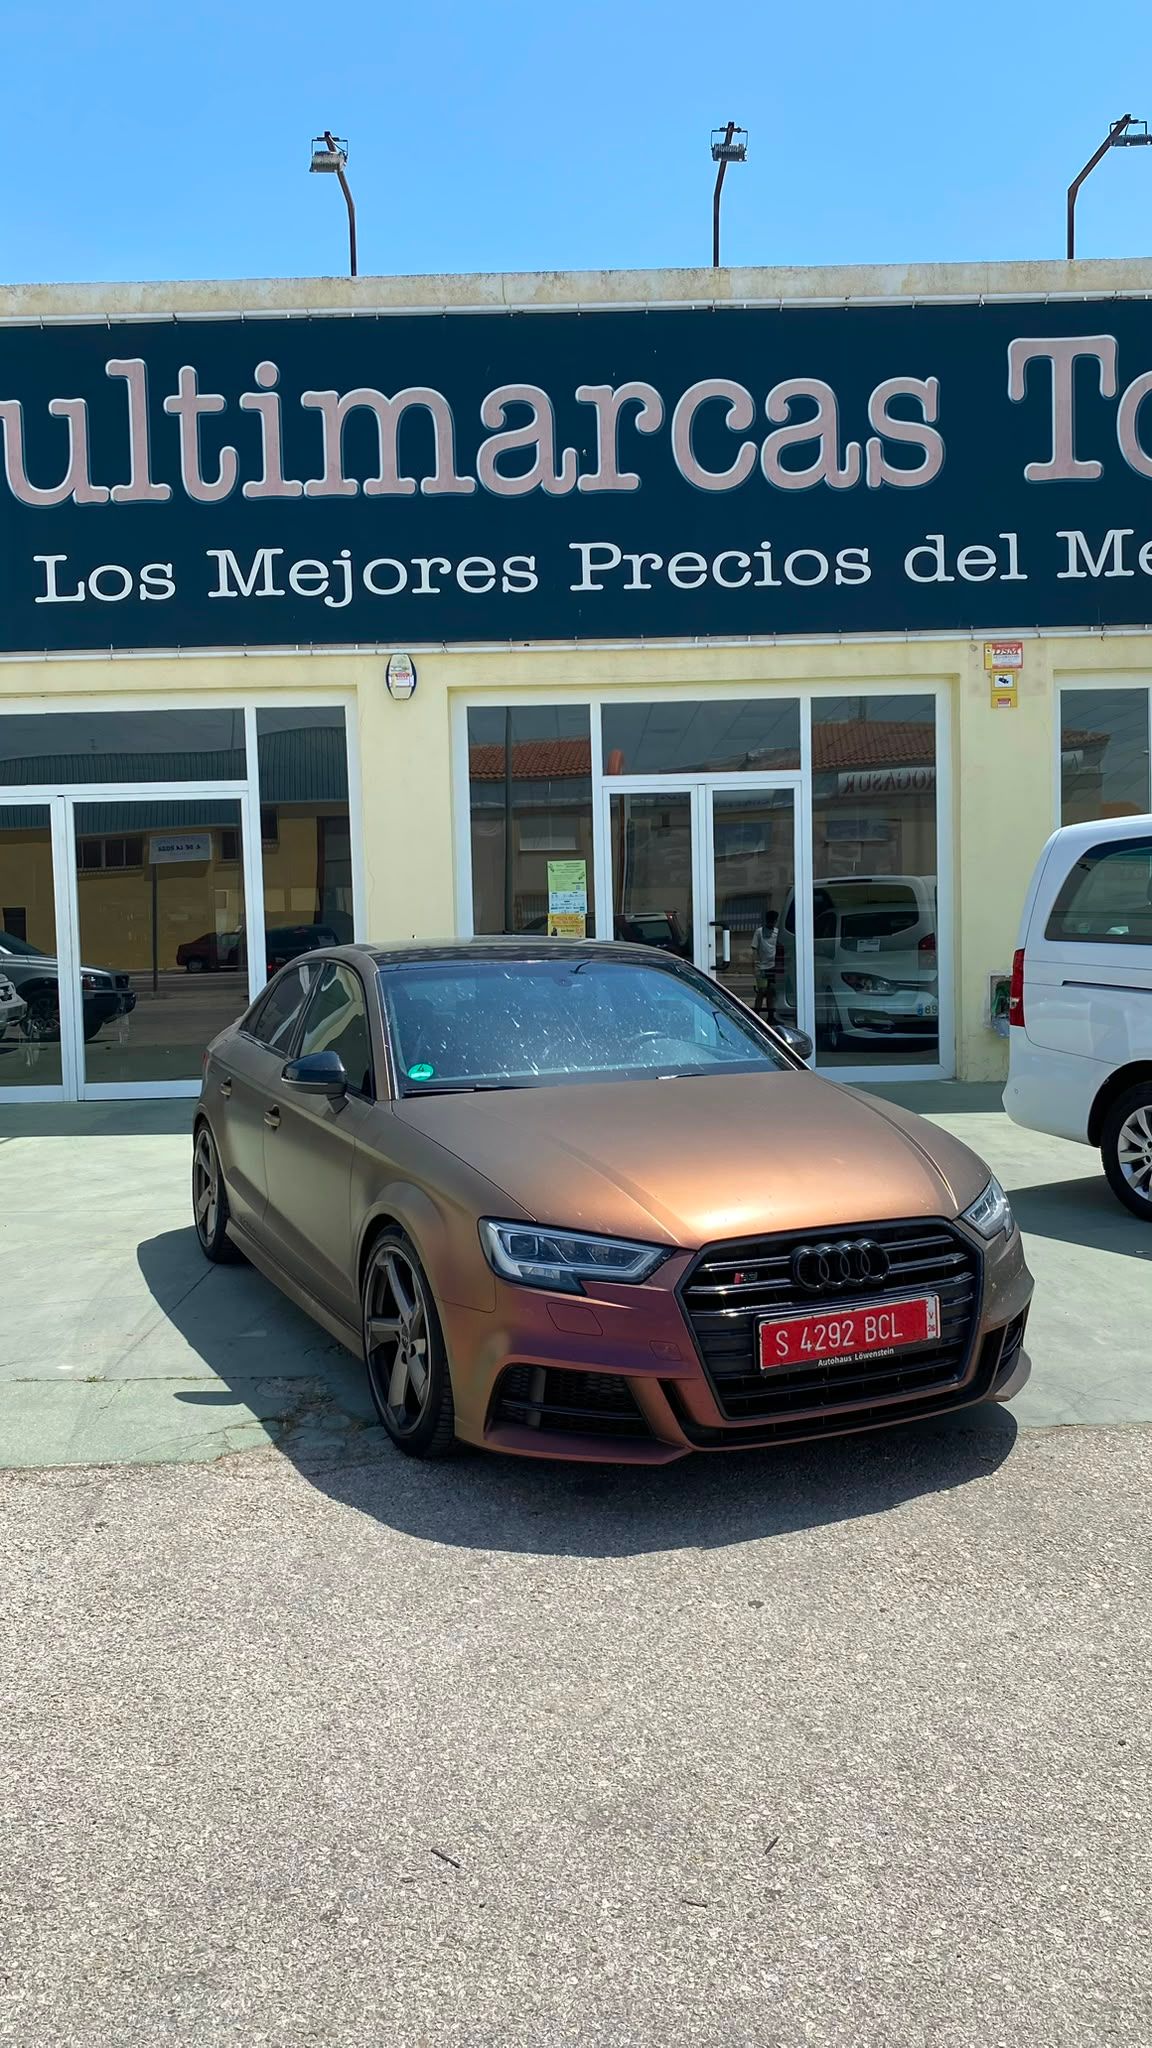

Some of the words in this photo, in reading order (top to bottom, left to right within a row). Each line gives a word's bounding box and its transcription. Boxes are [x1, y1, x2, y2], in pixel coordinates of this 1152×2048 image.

[33, 555, 177, 604] Los
[206, 548, 540, 608] Mejores
[568, 541, 872, 592] Precios
[904, 533, 1028, 583] del
[775, 1329, 789, 1357] S
[800, 1319, 855, 1352] 4292
[864, 1312, 903, 1343] BCL
[817, 1354, 852, 1367] Autohaus
[854, 1347, 895, 1361] Löwenstein
